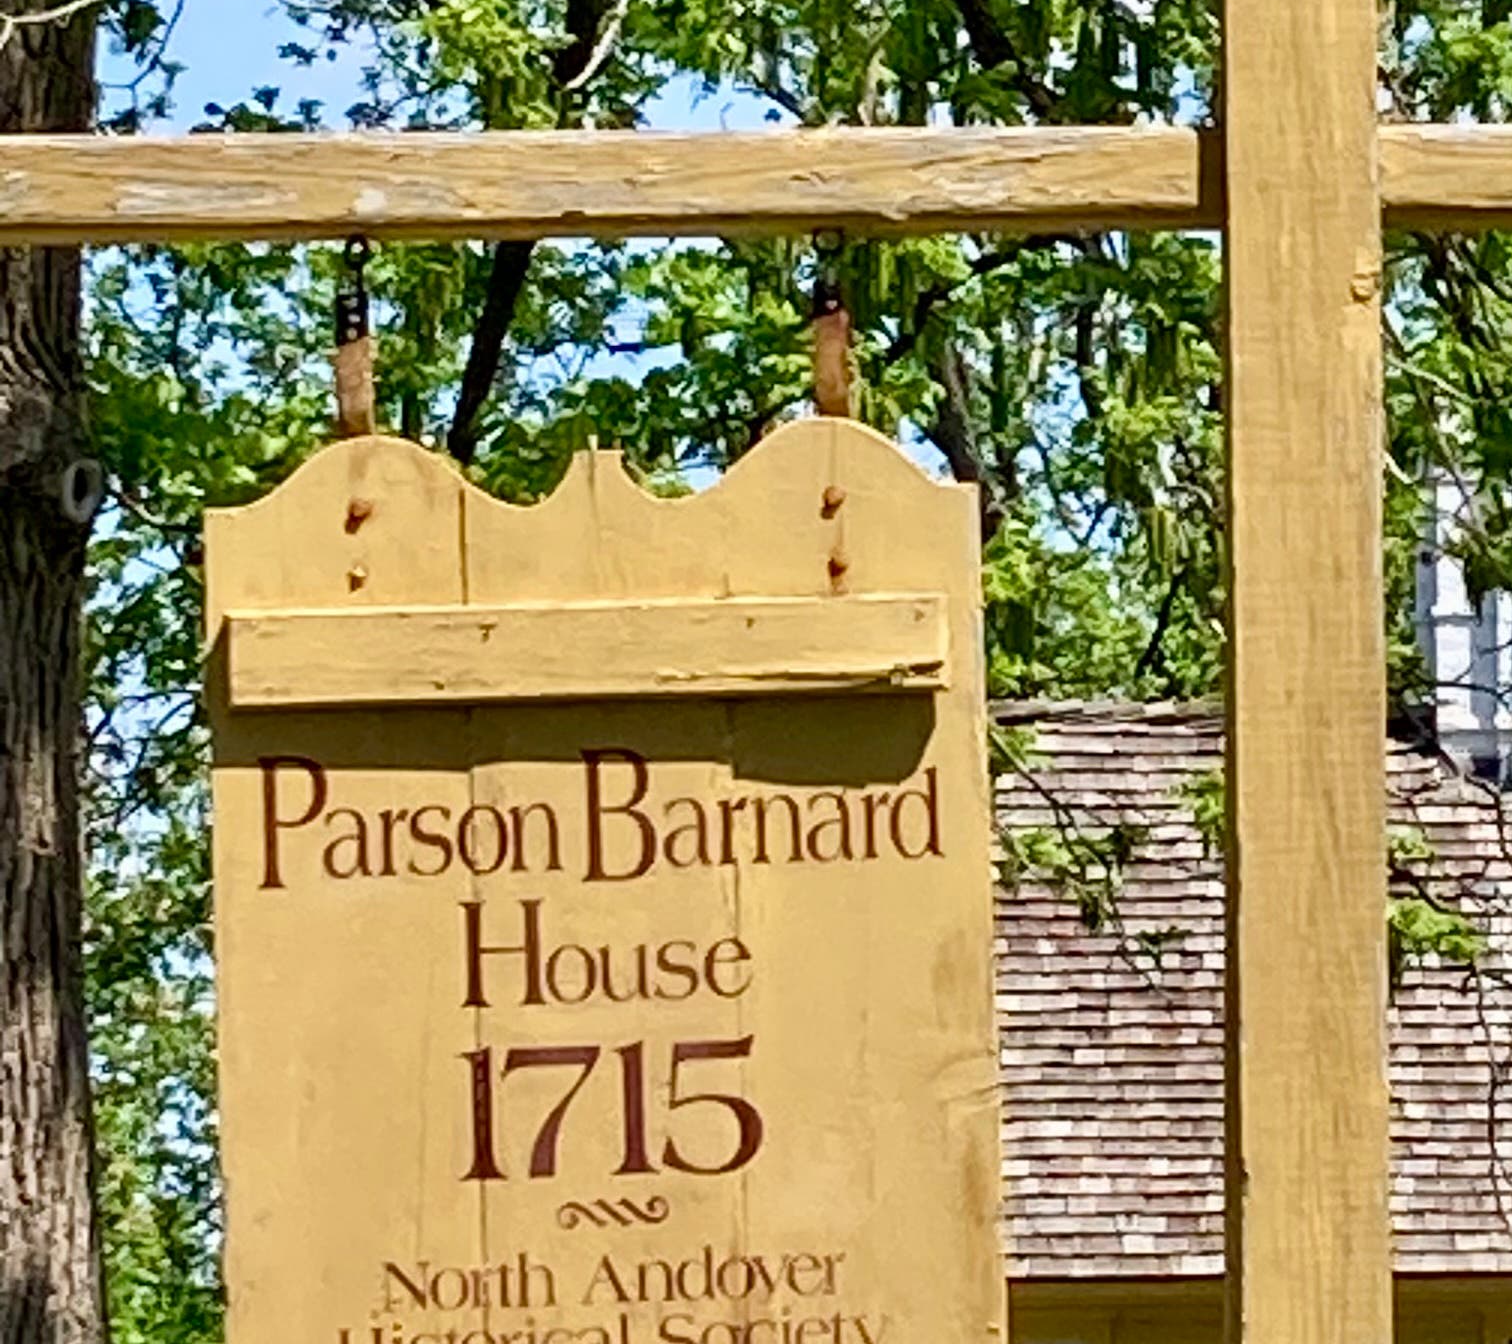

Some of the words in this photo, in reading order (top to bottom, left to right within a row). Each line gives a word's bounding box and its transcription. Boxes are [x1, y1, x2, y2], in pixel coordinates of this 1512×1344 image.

[256, 754, 564, 890] Parson
[579, 748, 946, 884] Barnard
[458, 899, 754, 1009] House
[459, 1034, 763, 1183] 1715
[381, 1253, 555, 1314] North
[582, 1245, 845, 1310] Andover
